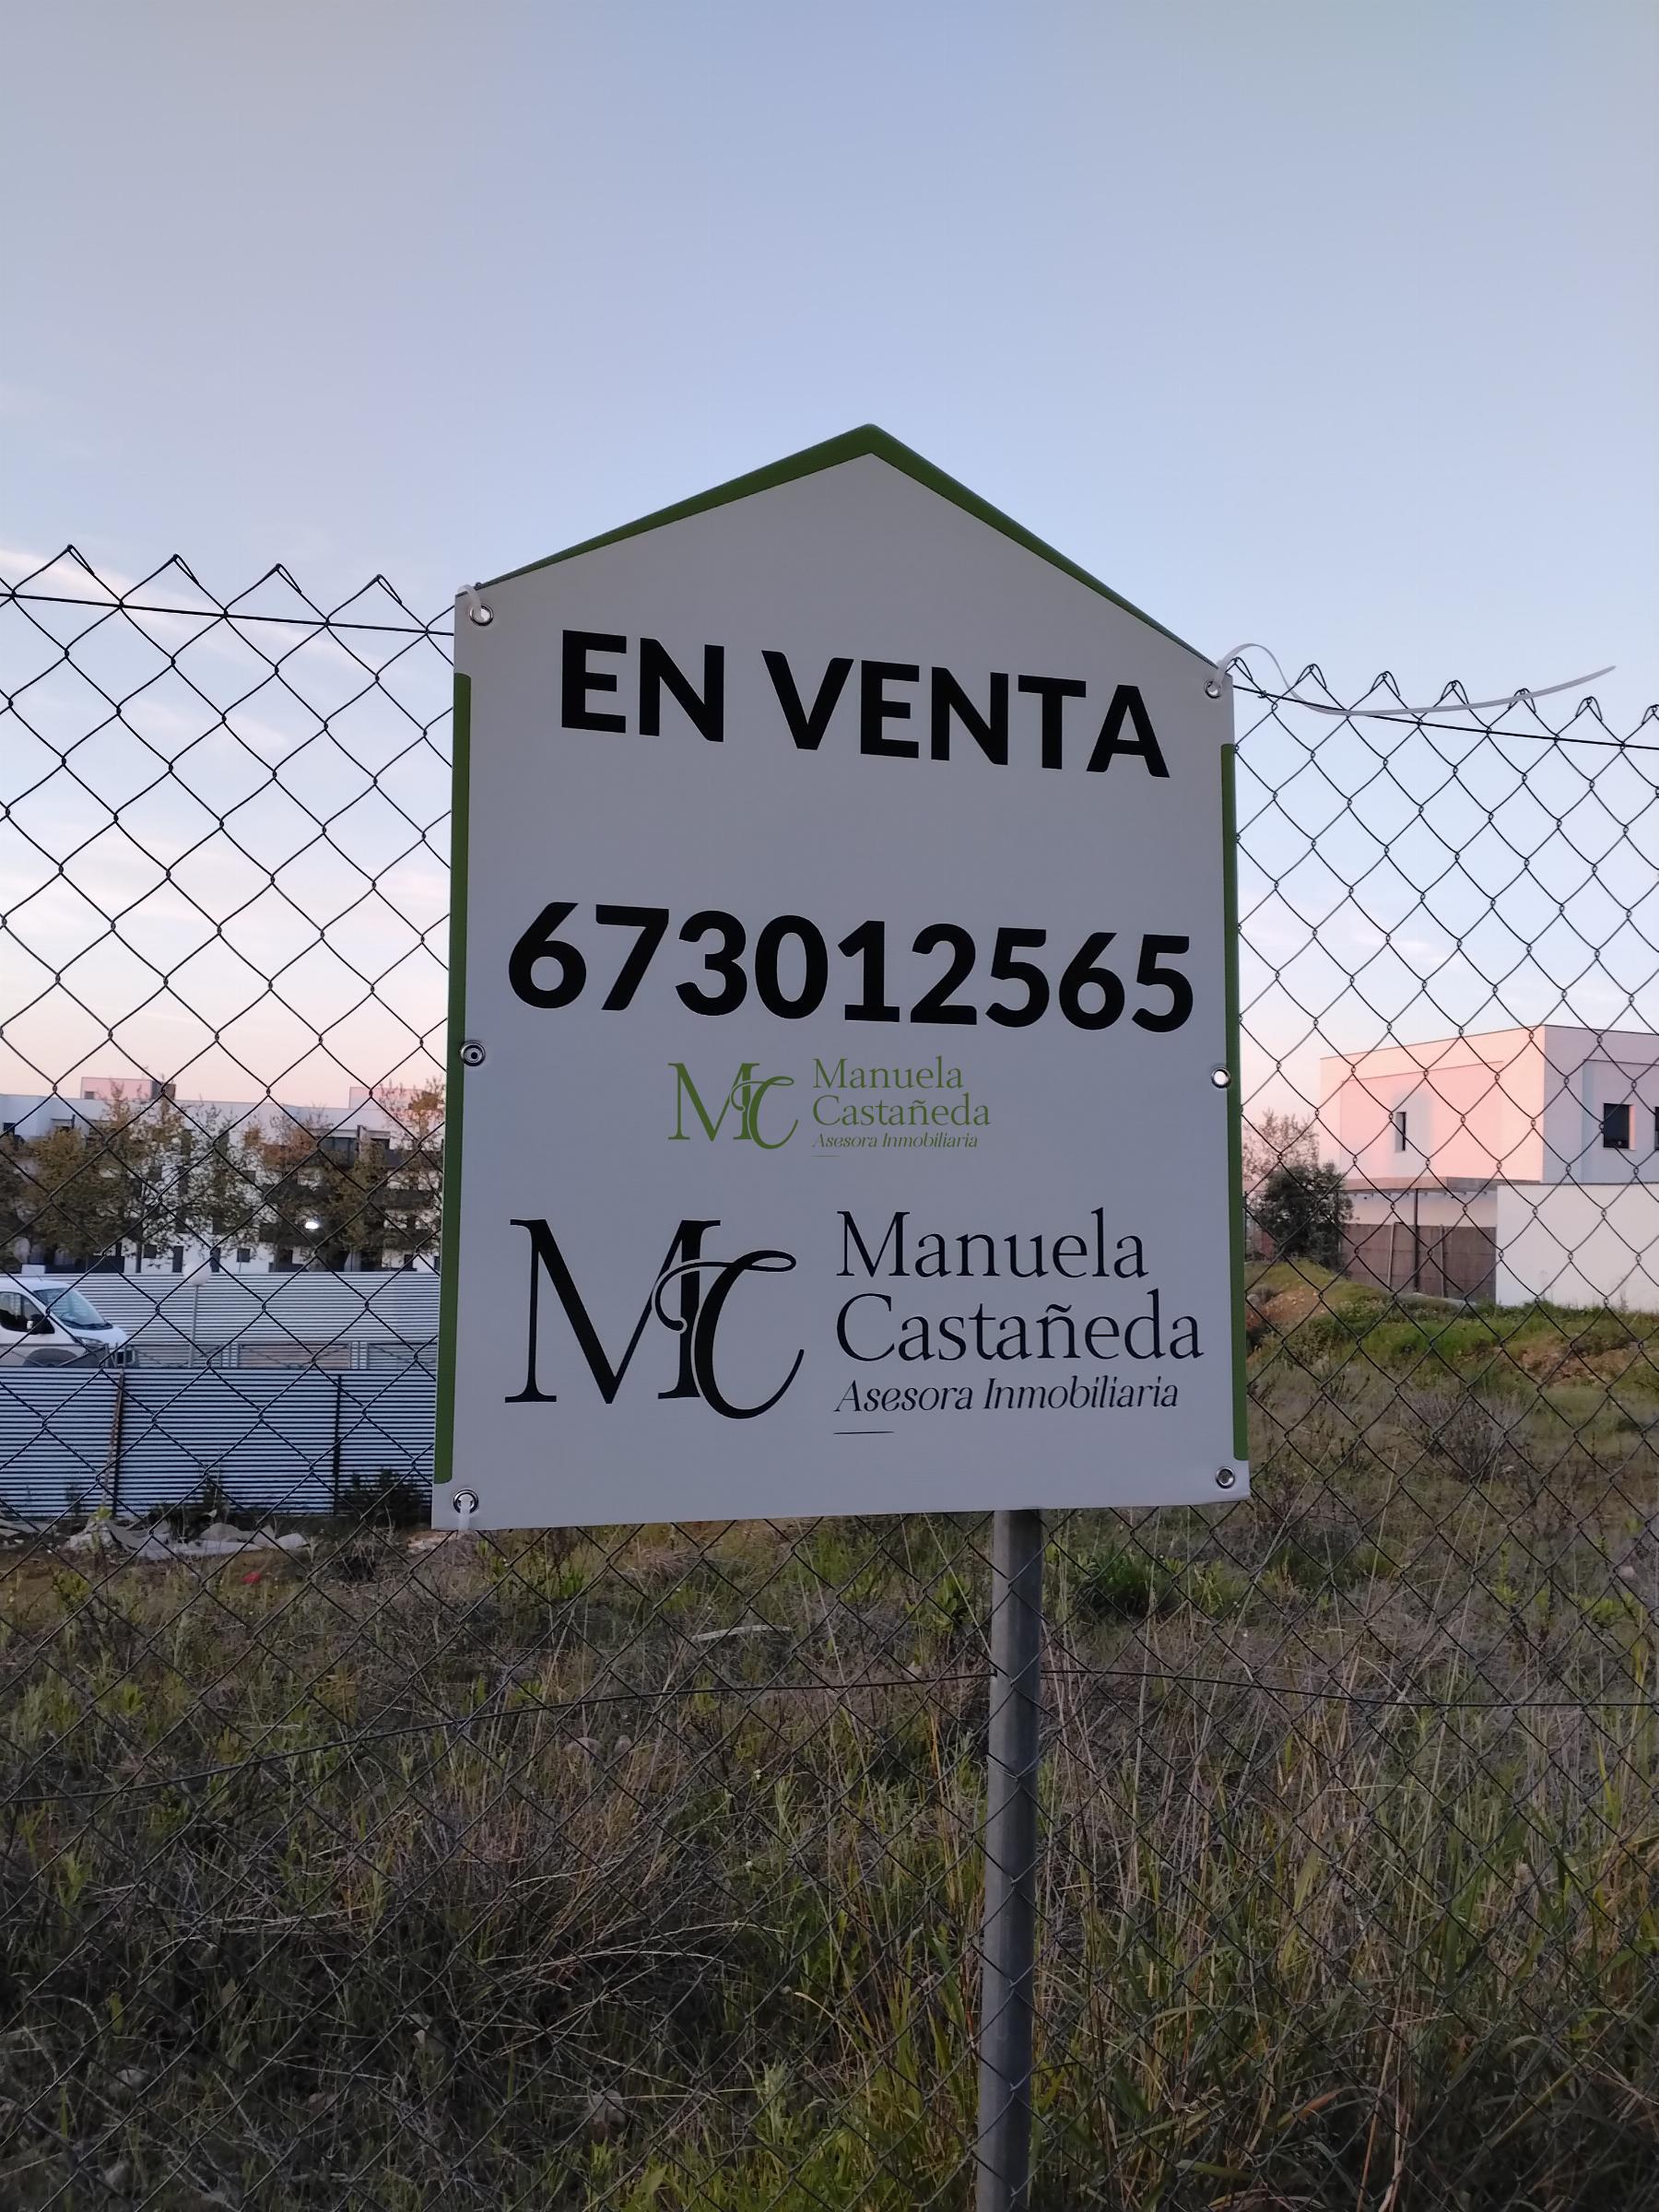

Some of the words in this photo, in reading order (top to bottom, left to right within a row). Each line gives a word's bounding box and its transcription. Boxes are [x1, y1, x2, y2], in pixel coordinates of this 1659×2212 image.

[561, 629, 724, 743] EN
[761, 650, 1171, 778] VENTA
[509, 901, 1194, 1032] 673012565
[812, 1055, 965, 1090] Manuela
[812, 1091, 992, 1127] Castañeda
[812, 1133, 877, 1148] Asesora
[881, 1131, 978, 1148] Inmobiliaria
[836, 1206, 1149, 1278] Manuela
[837, 1288, 1205, 1361] Castañeda
[833, 1378, 972, 1412] Asesora
[982, 1374, 1178, 1410] Inmobiliaria
